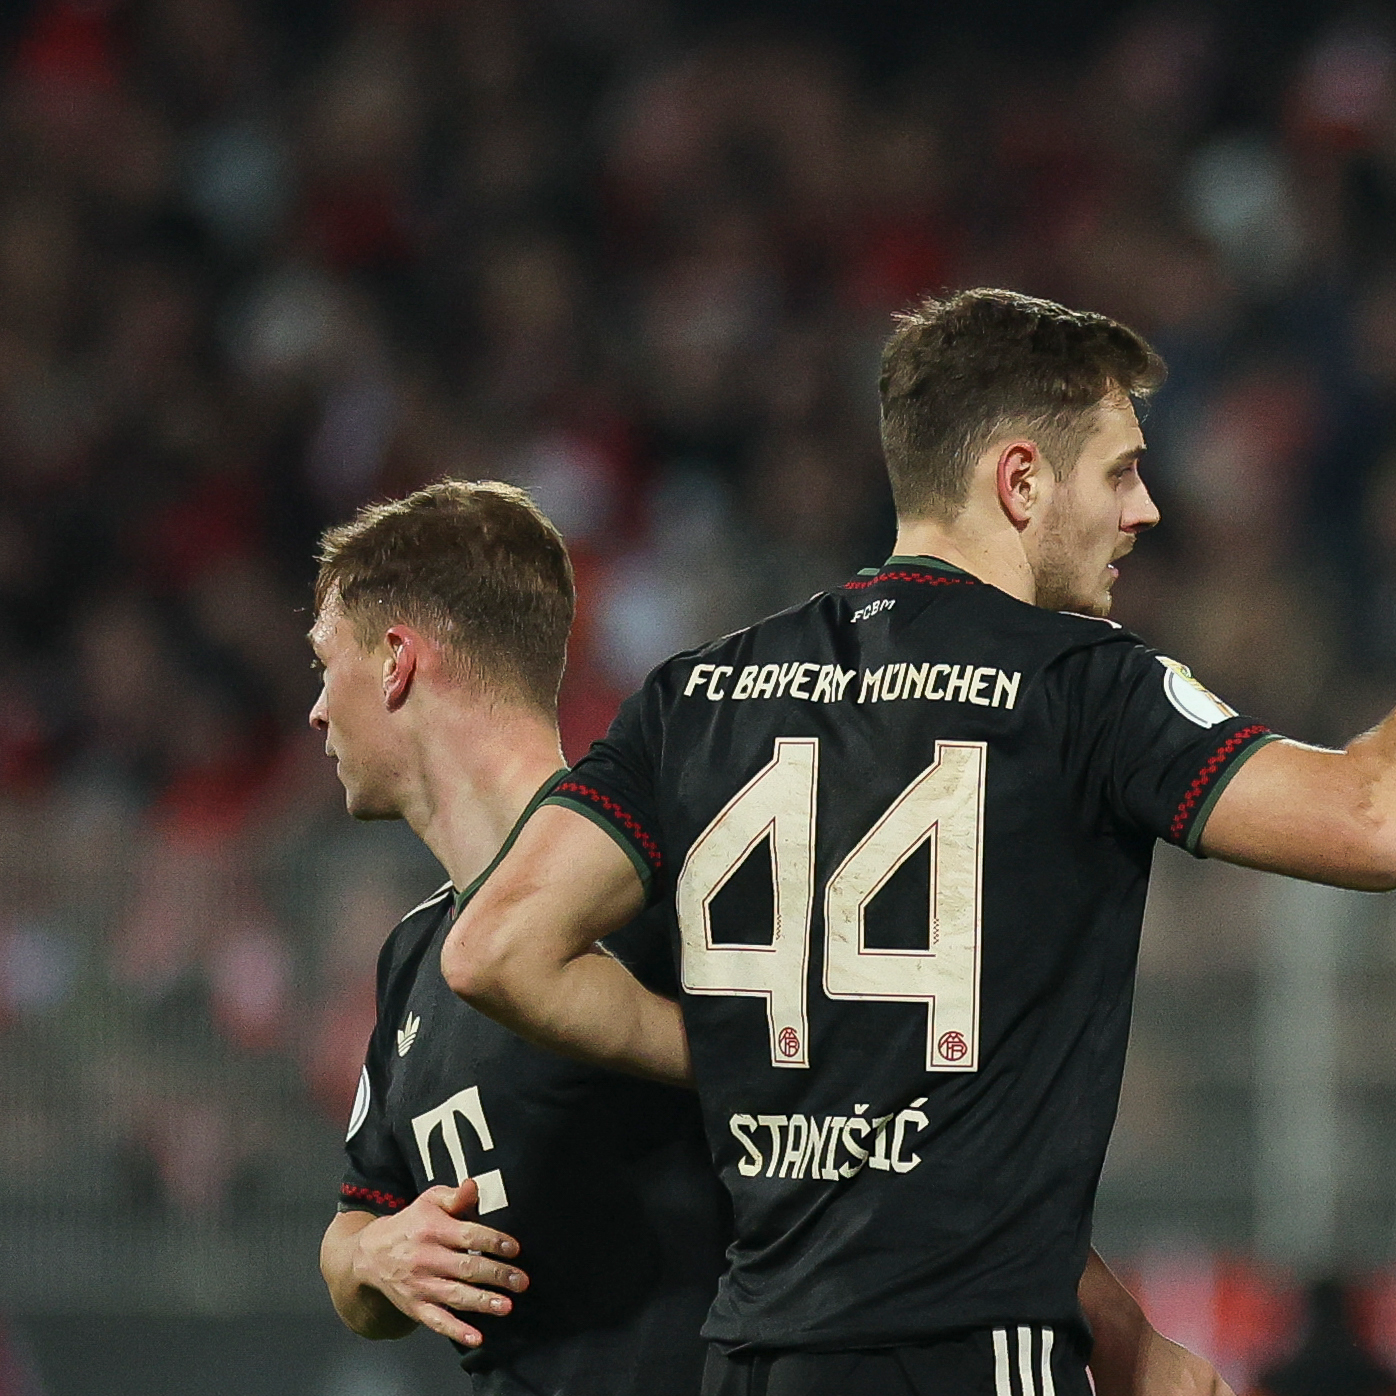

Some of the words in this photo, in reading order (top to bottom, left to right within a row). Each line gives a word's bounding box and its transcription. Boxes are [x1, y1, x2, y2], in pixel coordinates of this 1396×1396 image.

[850, 599, 896, 624] FCBM
[684, 663, 733, 701] FC
[857, 662, 1022, 710] MÜNCHEN
[676, 736, 988, 1073] 44
[729, 1097, 930, 1182] STANIŠIĆ
